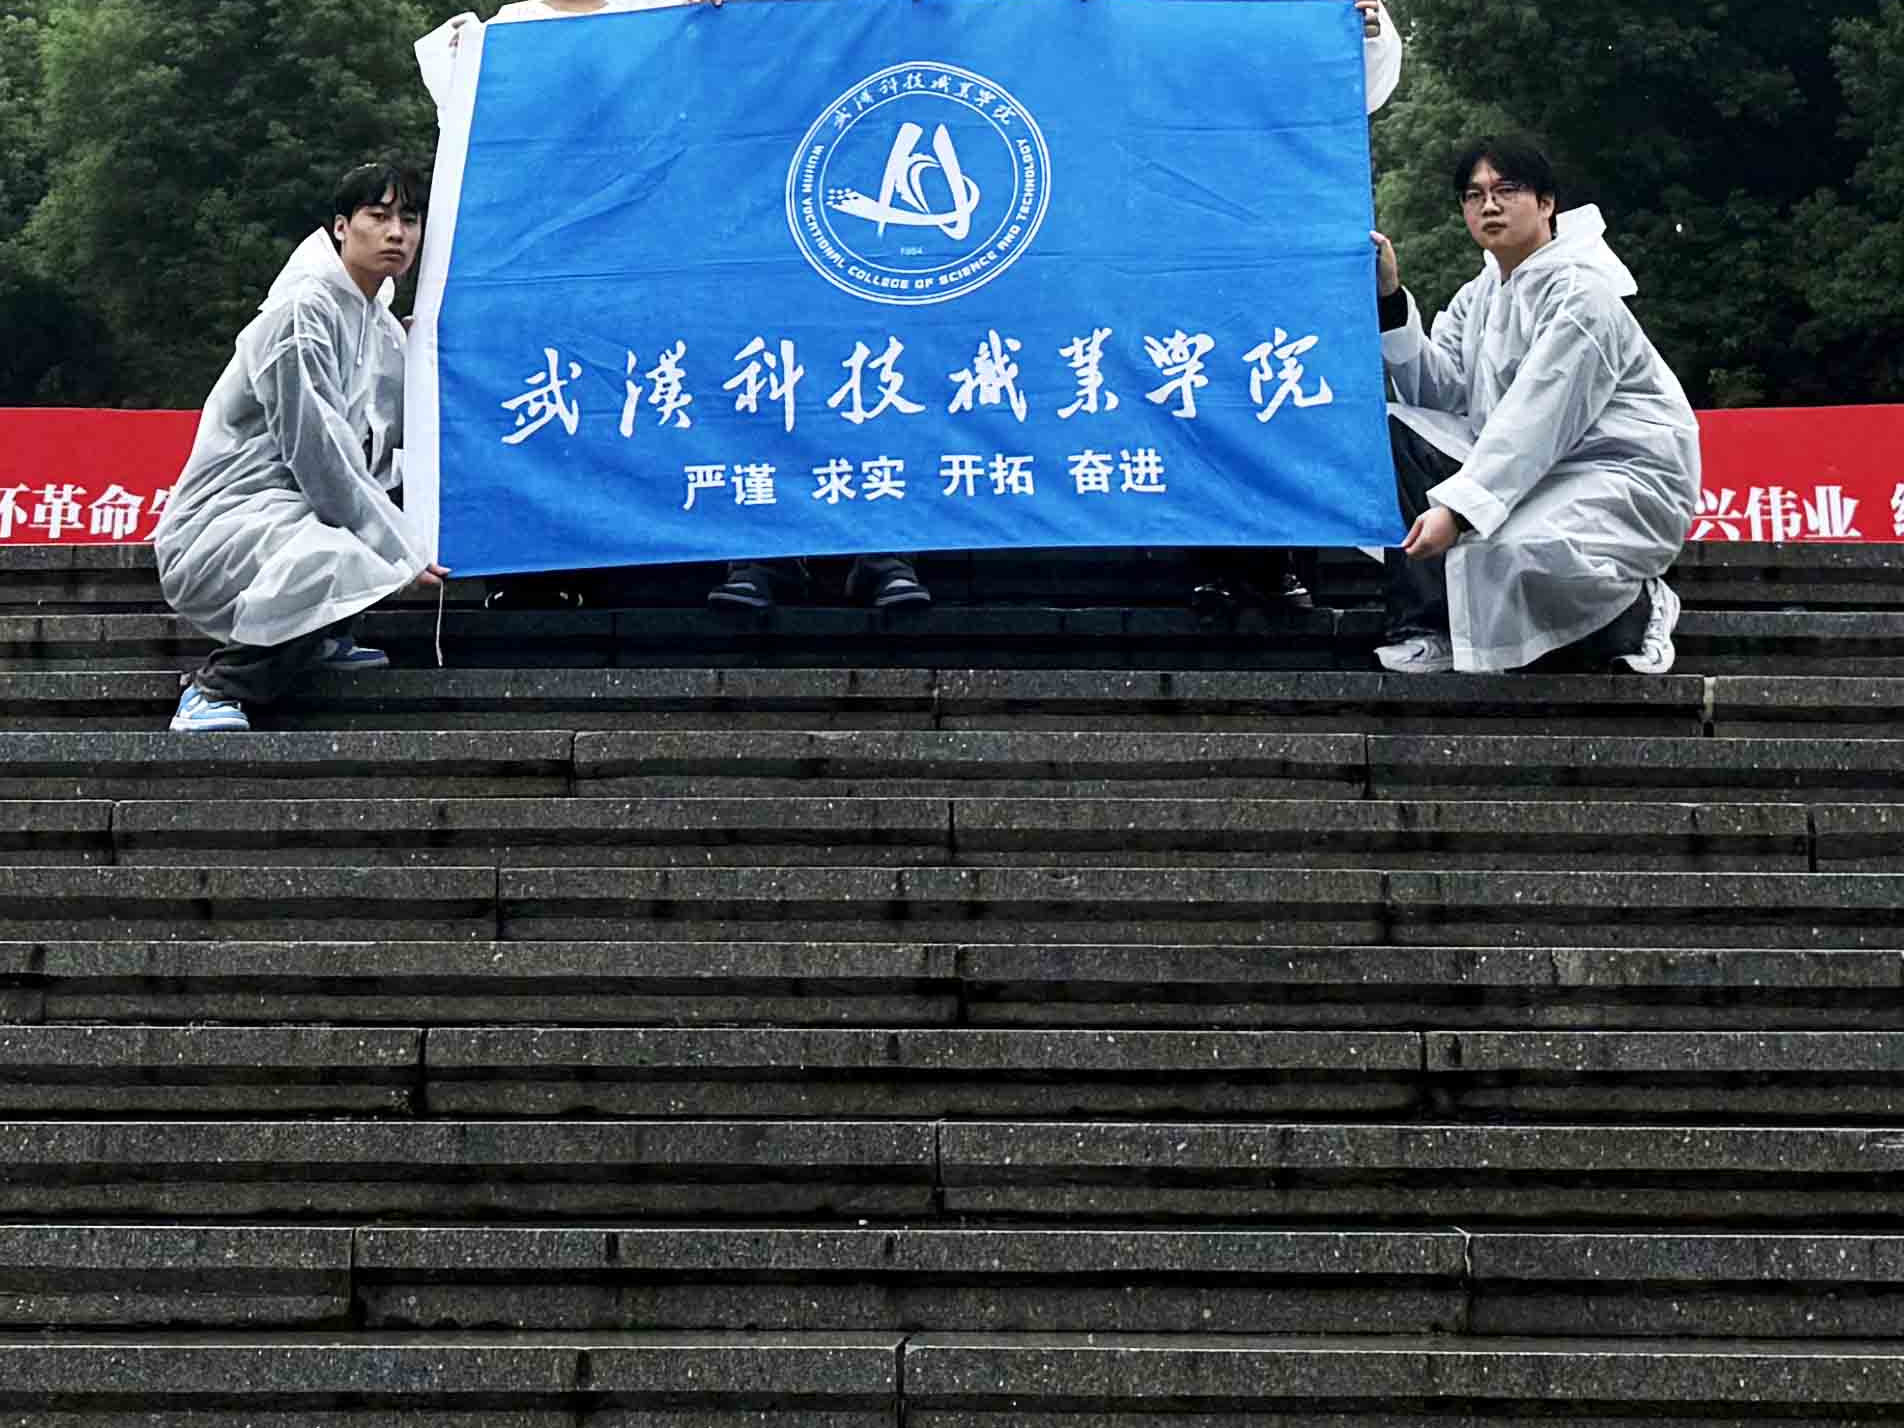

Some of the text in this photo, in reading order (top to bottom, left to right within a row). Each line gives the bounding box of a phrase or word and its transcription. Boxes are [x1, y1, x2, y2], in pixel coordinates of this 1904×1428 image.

[802, 198, 846, 268] VOCATIONAL
[848, 265, 909, 289] COLLEGE
[915, 278, 934, 289] OF
[939, 250, 998, 285] SCIENCE
[997, 224, 1022, 251] AND
[1016, 139, 1036, 221] TECHNOLOGY
[682, 448, 1167, 510] 严谨 求实 开拓 奋进
